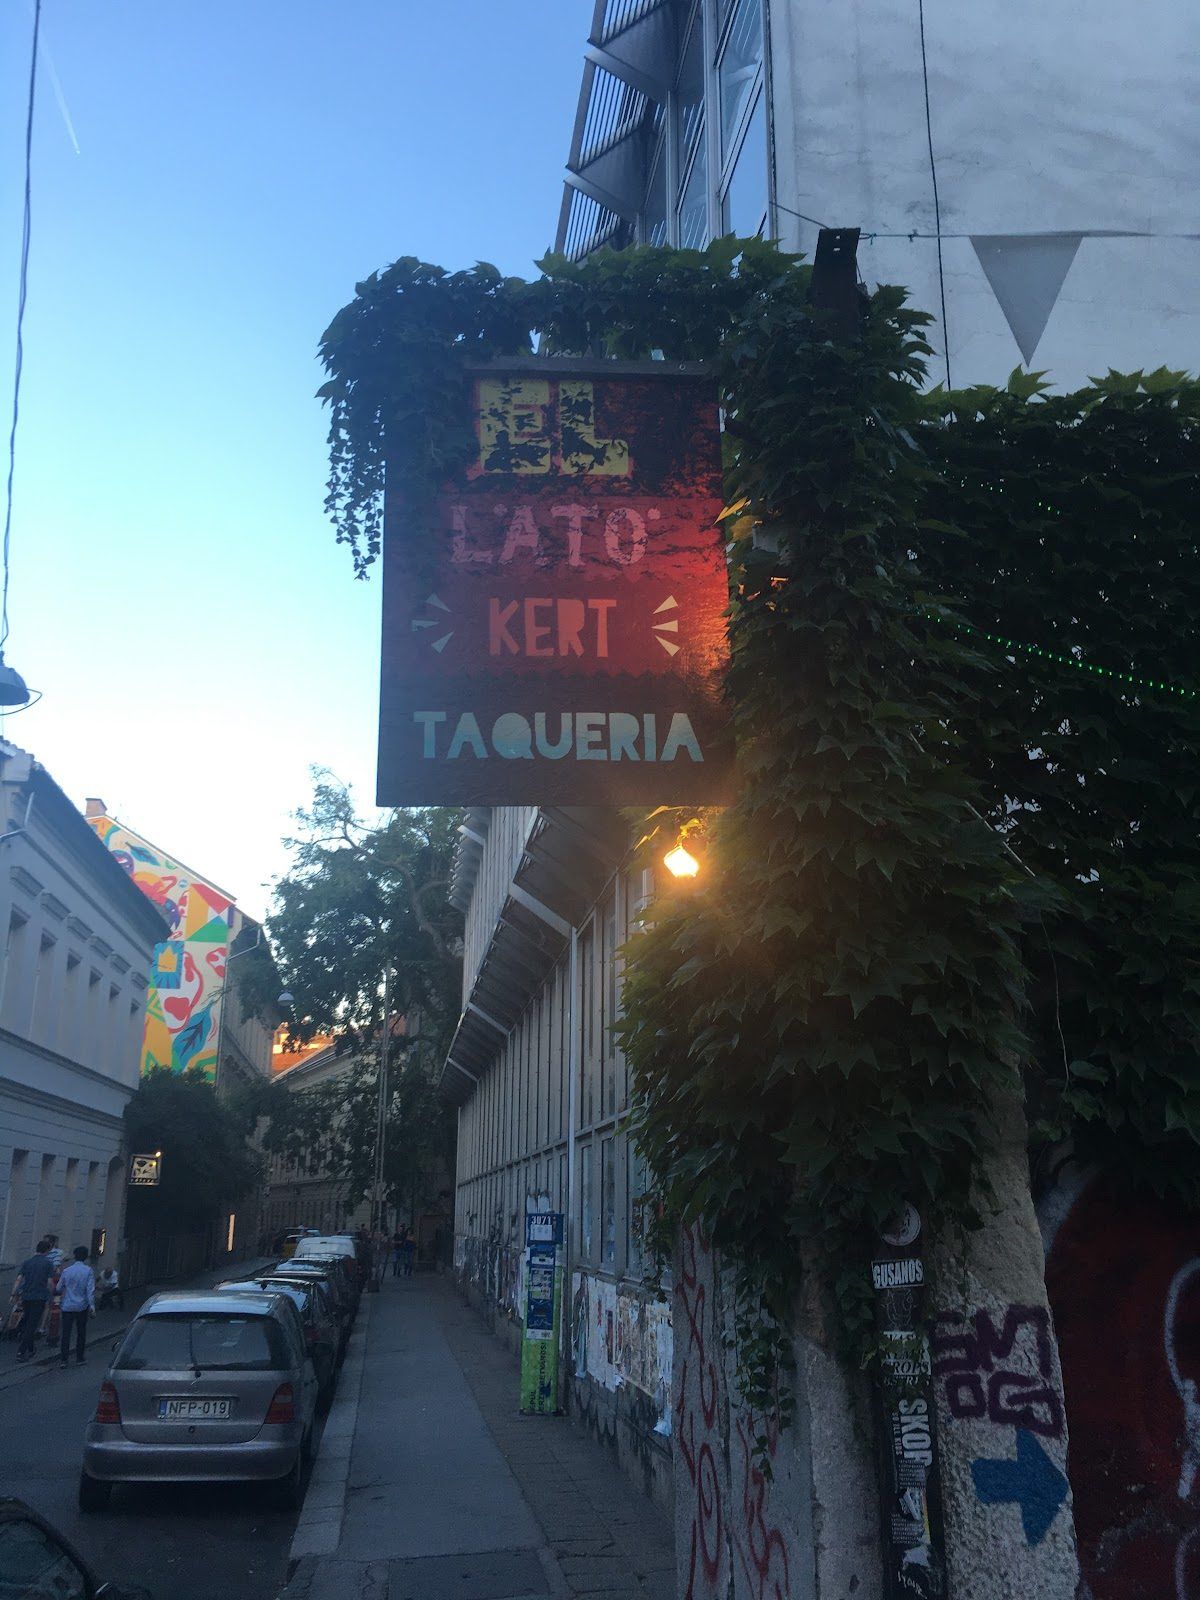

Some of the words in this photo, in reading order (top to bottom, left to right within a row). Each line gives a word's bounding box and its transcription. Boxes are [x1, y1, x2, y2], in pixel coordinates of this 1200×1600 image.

[478, 379, 631, 475] EL
[488, 597, 617, 659] KERT
[413, 711, 705, 762] TAQUERIA
[873, 1258, 924, 1288] GUSANOS
[168, 1401, 227, 1414] NFP-019
